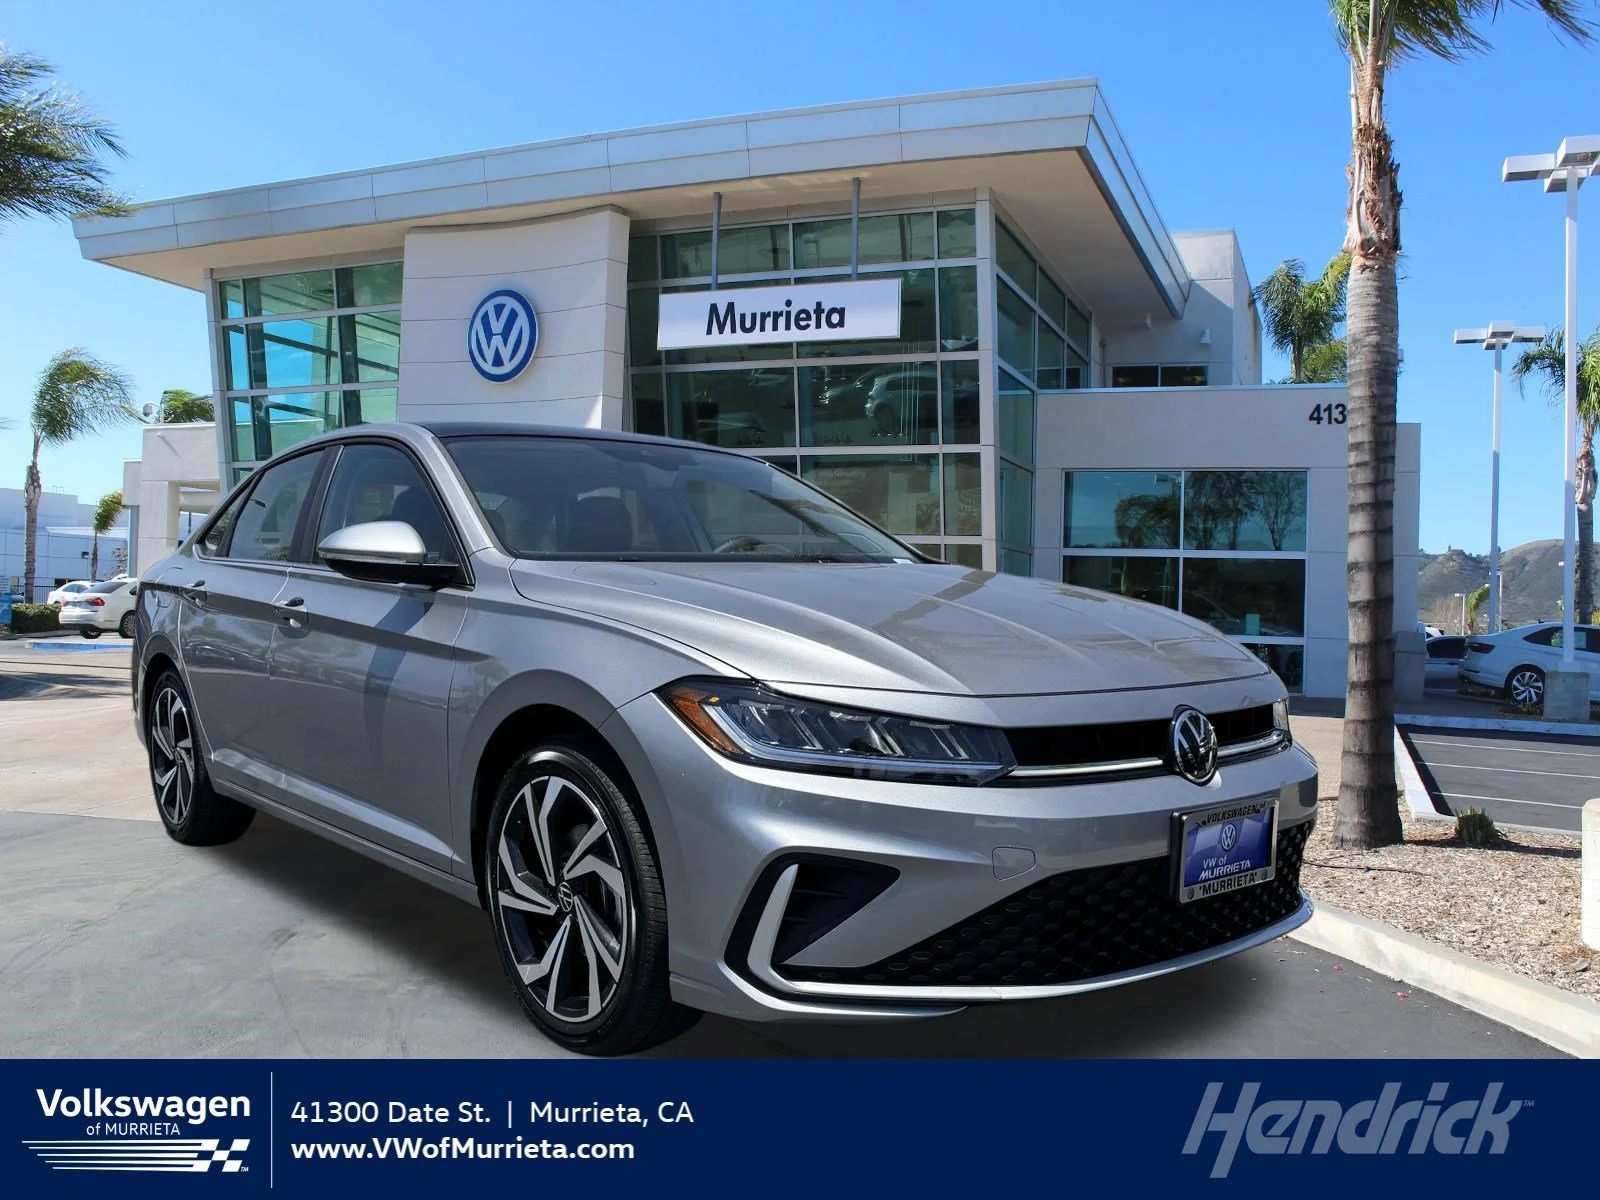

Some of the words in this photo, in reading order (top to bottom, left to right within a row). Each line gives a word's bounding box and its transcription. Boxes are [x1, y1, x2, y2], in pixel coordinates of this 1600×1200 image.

[706, 299, 846, 336] Murrieta
[1308, 403, 1347, 425] 413
[1206, 804, 1258, 824] VOLKSWAGEN
[1198, 859, 1252, 882] MURRIETA
[1203, 857, 1217, 870] VW
[1218, 855, 1228, 866] of
[1202, 872, 1256, 897] MURRIETA
